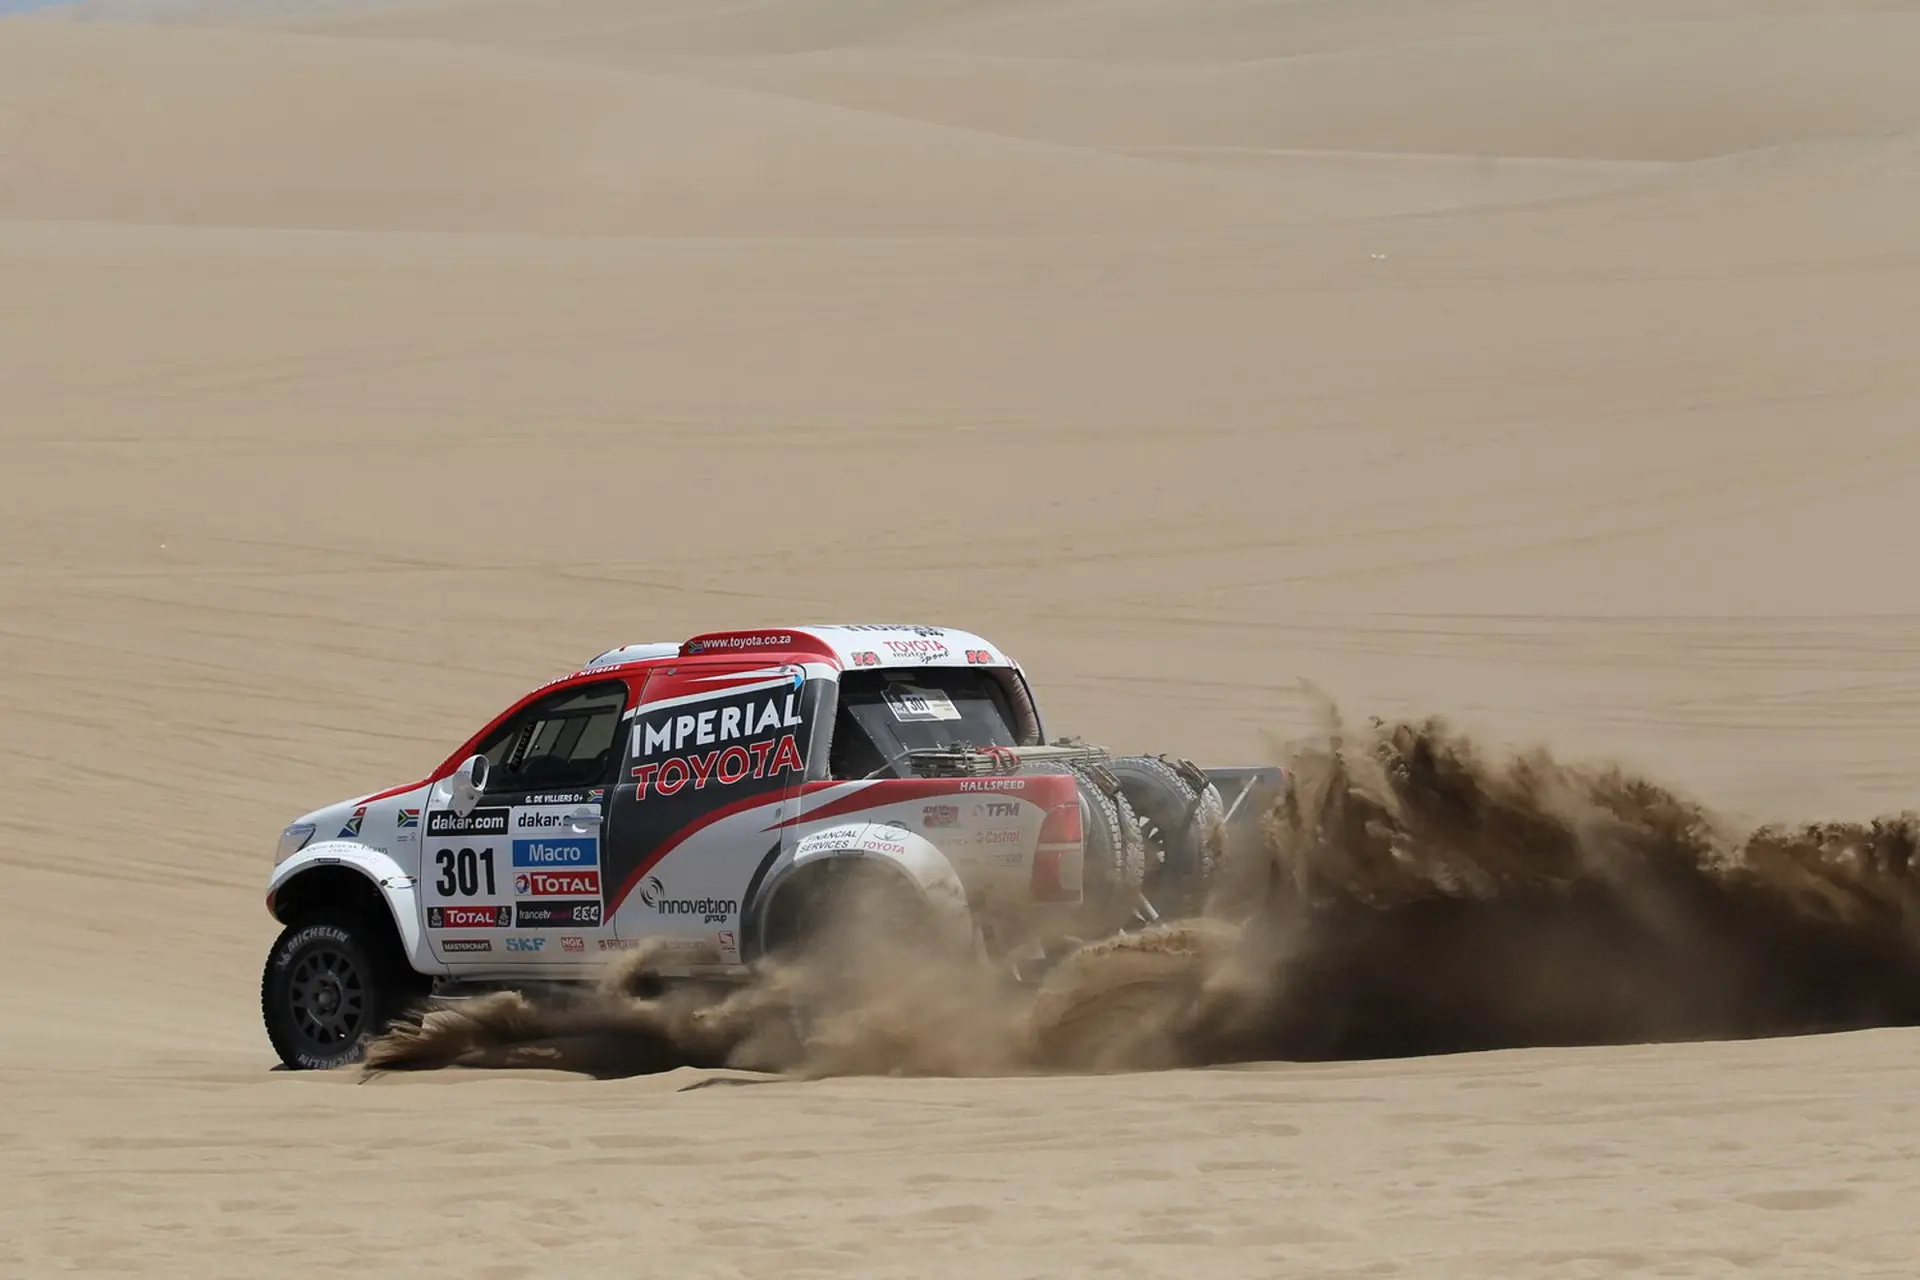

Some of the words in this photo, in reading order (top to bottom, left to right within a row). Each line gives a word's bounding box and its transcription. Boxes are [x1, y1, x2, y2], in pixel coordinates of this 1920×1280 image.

[702, 634, 792, 649] www.toyota.co.za
[882, 639, 948, 652] TOYOTA
[892, 650, 927, 658] motor
[905, 696, 930, 712] 301
[632, 693, 803, 759] IMPERIAL
[631, 733, 805, 801] TOYOTA
[960, 780, 1025, 792] HALLSPEED
[542, 794, 573, 803] VILLIERS
[986, 802, 1021, 817] TFM
[431, 814, 504, 831] dakar.com
[528, 843, 581, 862] Macro
[800, 840, 850, 853] SERVICES
[862, 840, 905, 855] TOYOTA
[435, 847, 496, 897] 301
[532, 874, 598, 892] TOTAL
[658, 896, 737, 914] innovation
[446, 909, 495, 924] TOTAL
[704, 914, 727, 924] group
[287, 926, 348, 952] MICHELIN
[506, 937, 546, 952] SKF
[562, 937, 583, 948] NGK
